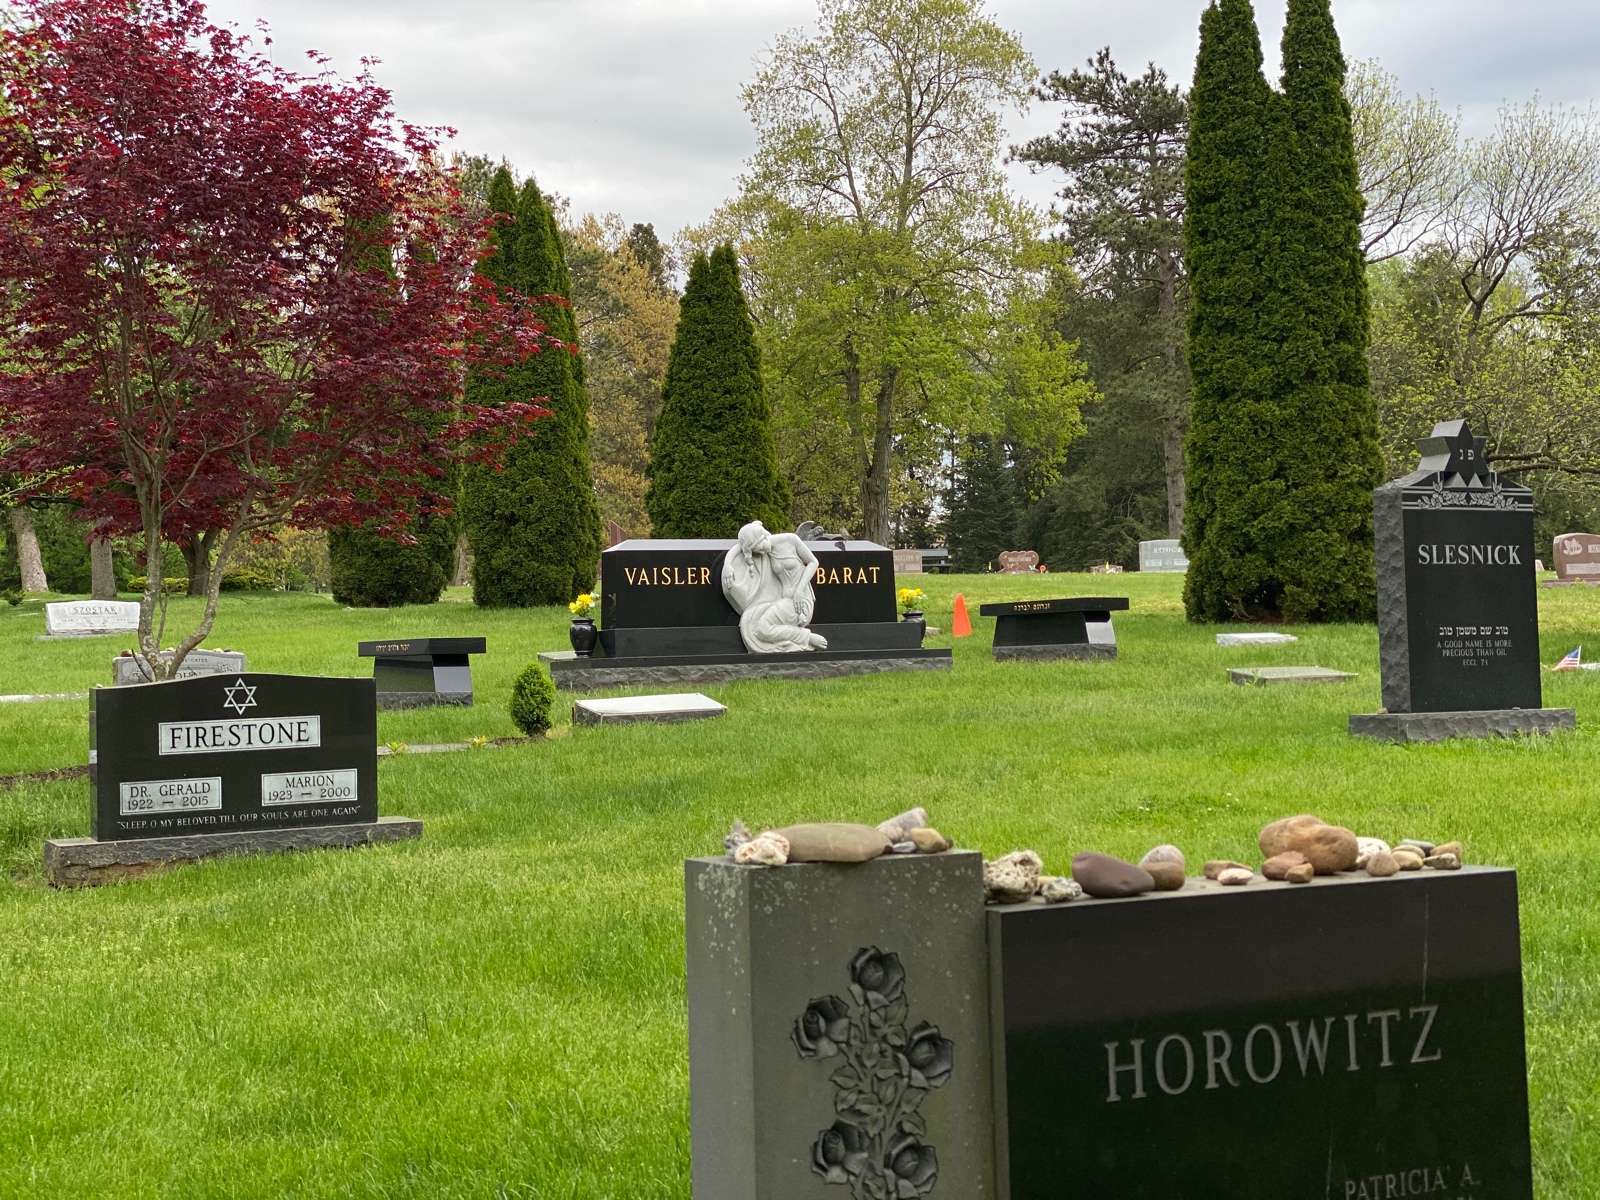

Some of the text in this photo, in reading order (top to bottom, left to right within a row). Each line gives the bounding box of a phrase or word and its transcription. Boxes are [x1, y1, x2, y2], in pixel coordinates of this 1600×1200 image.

[1418, 544, 1522, 565] SLESNICK
[624, 567, 711, 585] VAISLER
[816, 566, 880, 585] BARAT
[73, 606, 116, 614] SZOSTAK
[1439, 626, 1453, 635] טוב
[1480, 626, 1492, 635] שם
[1495, 626, 1509, 635] טוב
[1444, 640, 1463, 648] GOOD
[1465, 640, 1483, 648] NAME
[1486, 640, 1492, 648] IS
[1494, 640, 1512, 648] MORE
[1442, 648, 1507, 657] PRECIOUS THAN OIL
[170, 721, 310, 749] FIRESTONE
[285, 775, 335, 788] MARION
[130, 782, 211, 798] DR. GERALD
[268, 790, 293, 801] 1923
[320, 786, 351, 798] 2000
[128, 799, 153, 810] 1922
[182, 796, 209, 807] 2015
[150, 820, 157, 828] O
[160, 819, 174, 828] MY
[219, 814, 238, 824] TILL
[239, 813, 258, 822] OUR
[261, 811, 289, 820] SOULS
[292, 810, 308, 819] ARE
[311, 808, 329, 817] ONE
[1104, 1003, 1442, 1102] HOROWITZ
[1344, 1162, 1481, 1200] PATRICIA A.
